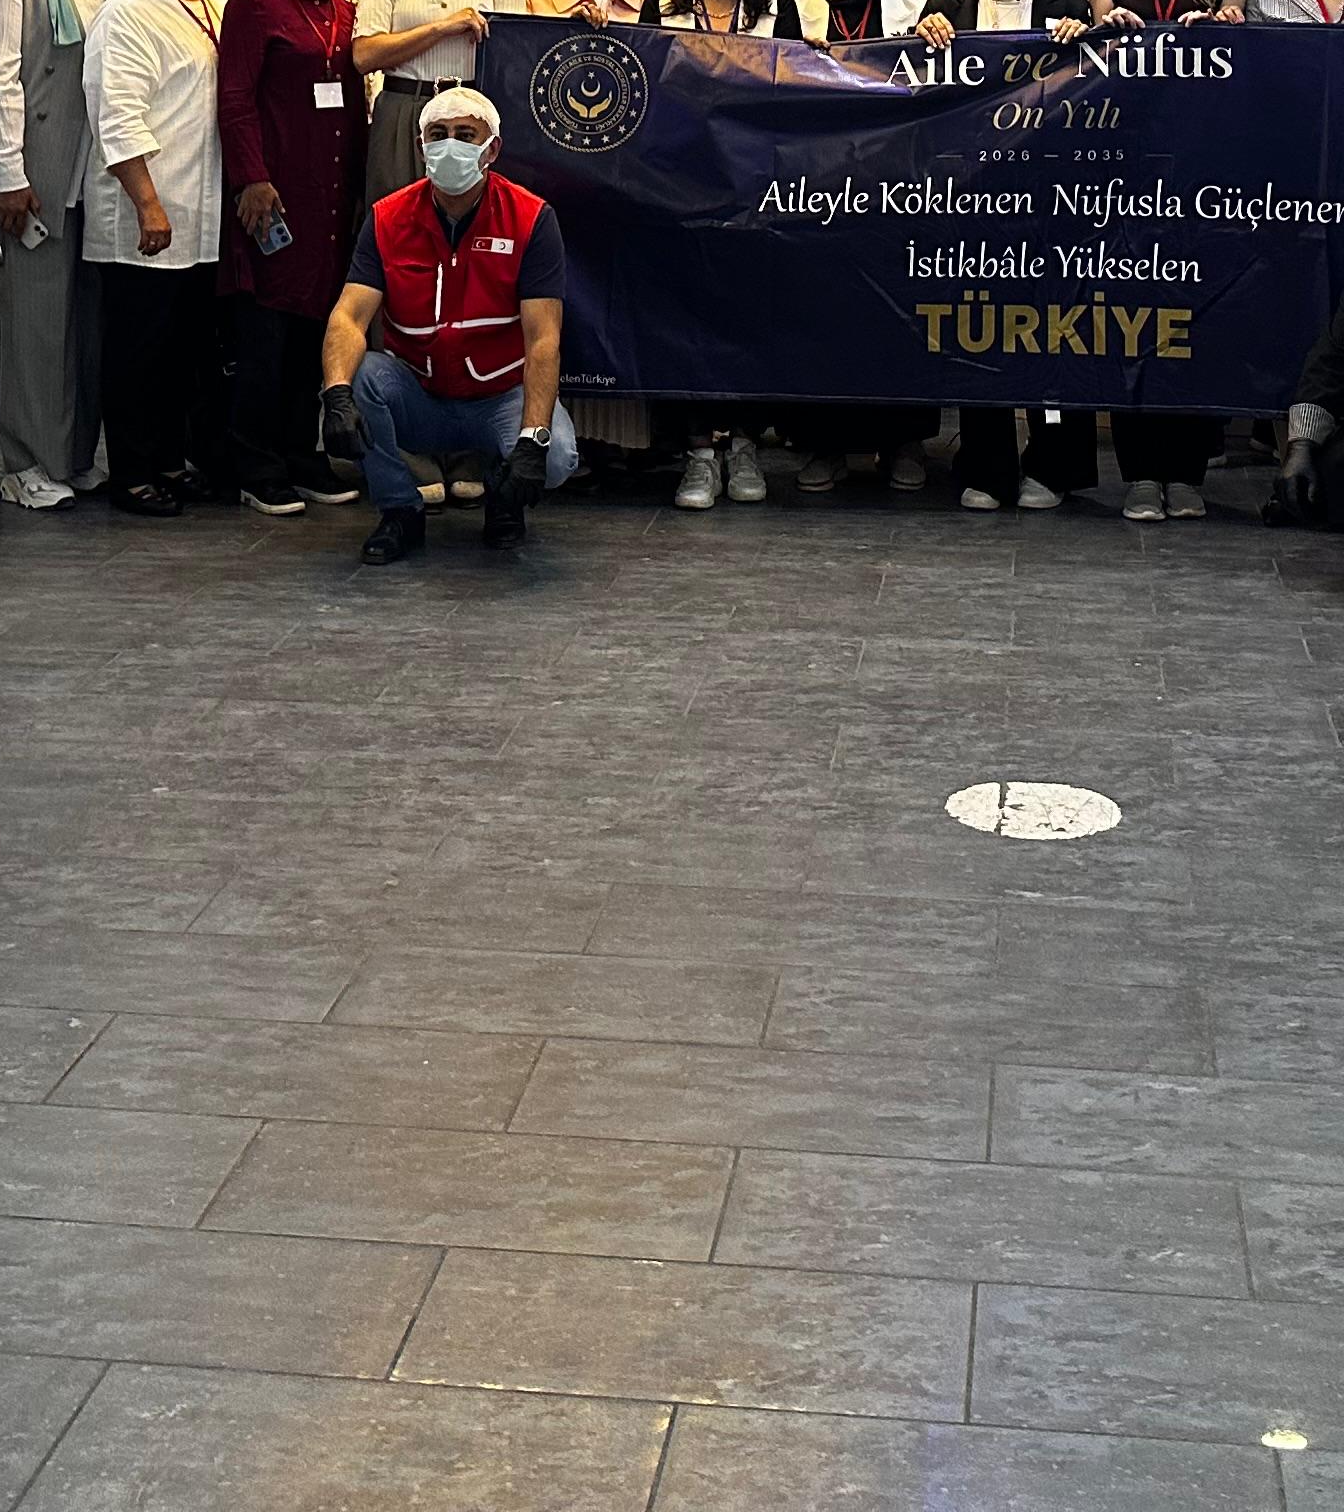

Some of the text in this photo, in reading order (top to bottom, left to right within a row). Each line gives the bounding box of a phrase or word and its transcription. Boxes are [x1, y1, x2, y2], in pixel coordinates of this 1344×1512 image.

[884, 33, 1233, 87] Aile ve Nüfus
[992, 97, 1121, 130] On Yılı
[979, 149, 1125, 162] 2026 2035
[758, 176, 869, 225] Aileyle
[879, 176, 1035, 215] Köklenen
[1052, 178, 1185, 228] Nüfusla
[906, 240, 1203, 283] İstikbâle Yükselen
[916, 290, 1193, 358] TÜRKİYE
[560, 373, 617, 387] elenTürkiye
